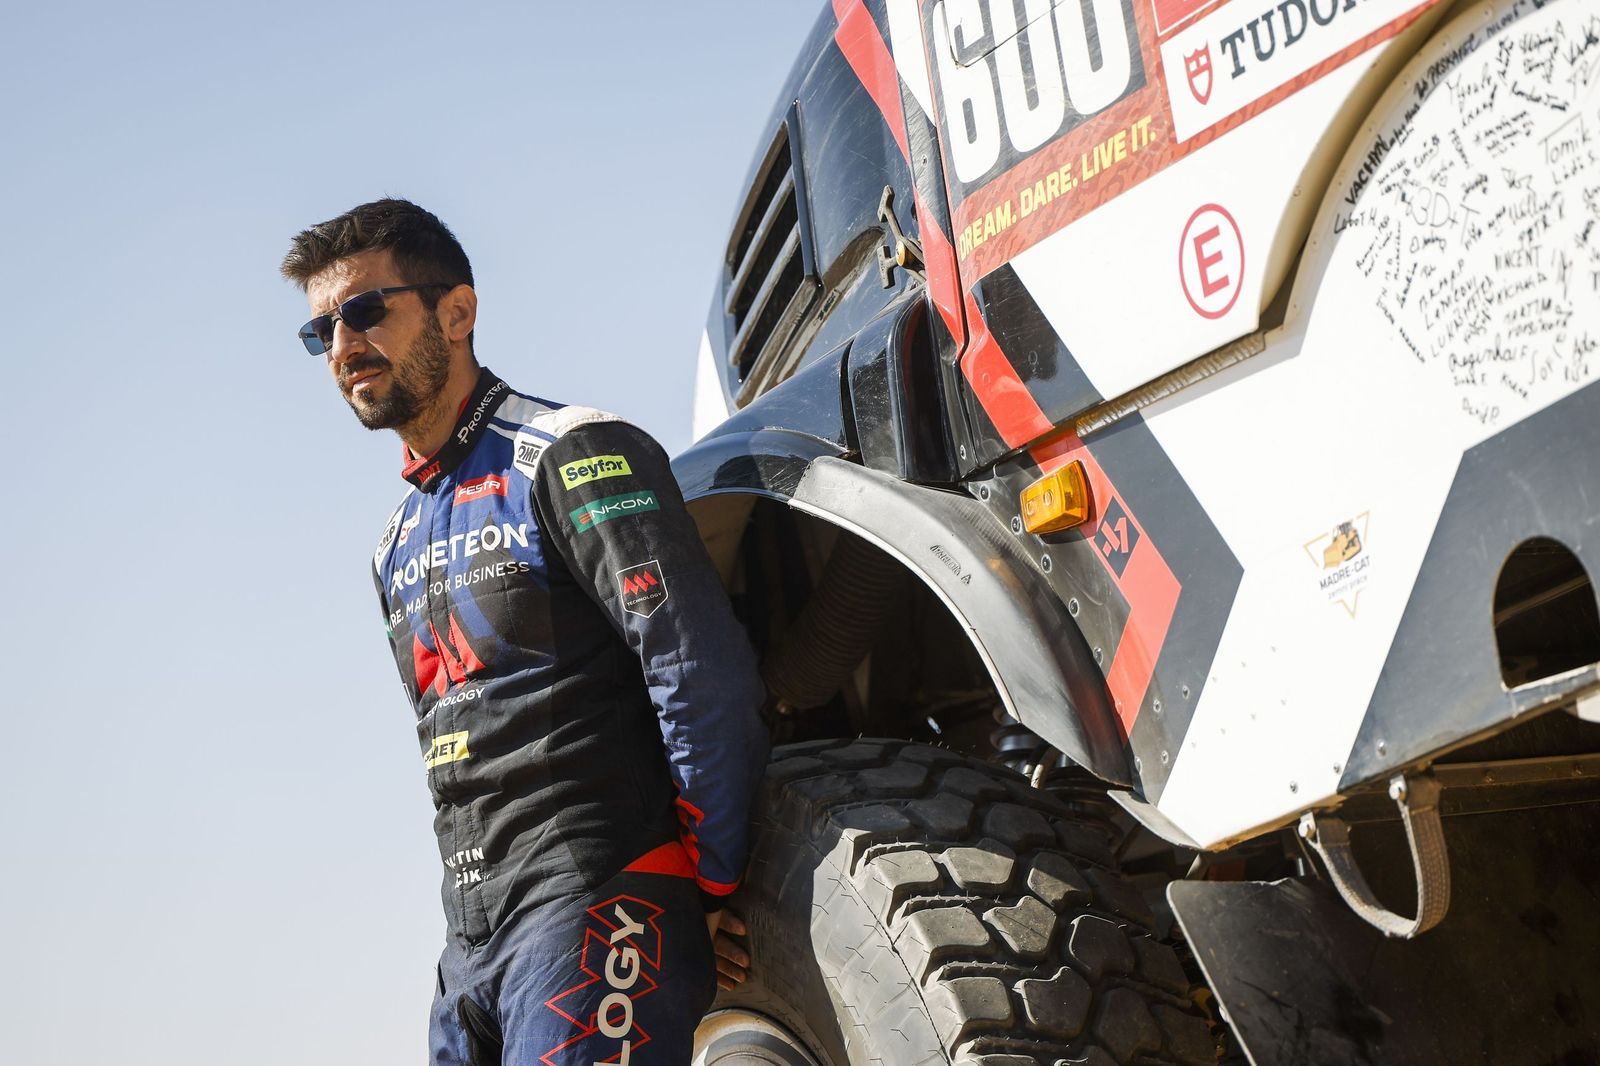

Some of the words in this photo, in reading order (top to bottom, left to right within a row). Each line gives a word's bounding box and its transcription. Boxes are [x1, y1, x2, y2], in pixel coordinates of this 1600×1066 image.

[1220, 0, 1368, 79] TUDO
[932, 0, 1131, 183] 600
[959, 199, 1017, 262] DREAM.
[1020, 162, 1079, 219] DARE.
[1081, 129, 1127, 182] LIVE
[1131, 114, 1156, 152] IT.
[1194, 226, 1230, 298] E
[458, 480, 500, 498] FESTA
[518, 445, 540, 463] OMP
[454, 561, 531, 590] BUSINESS
